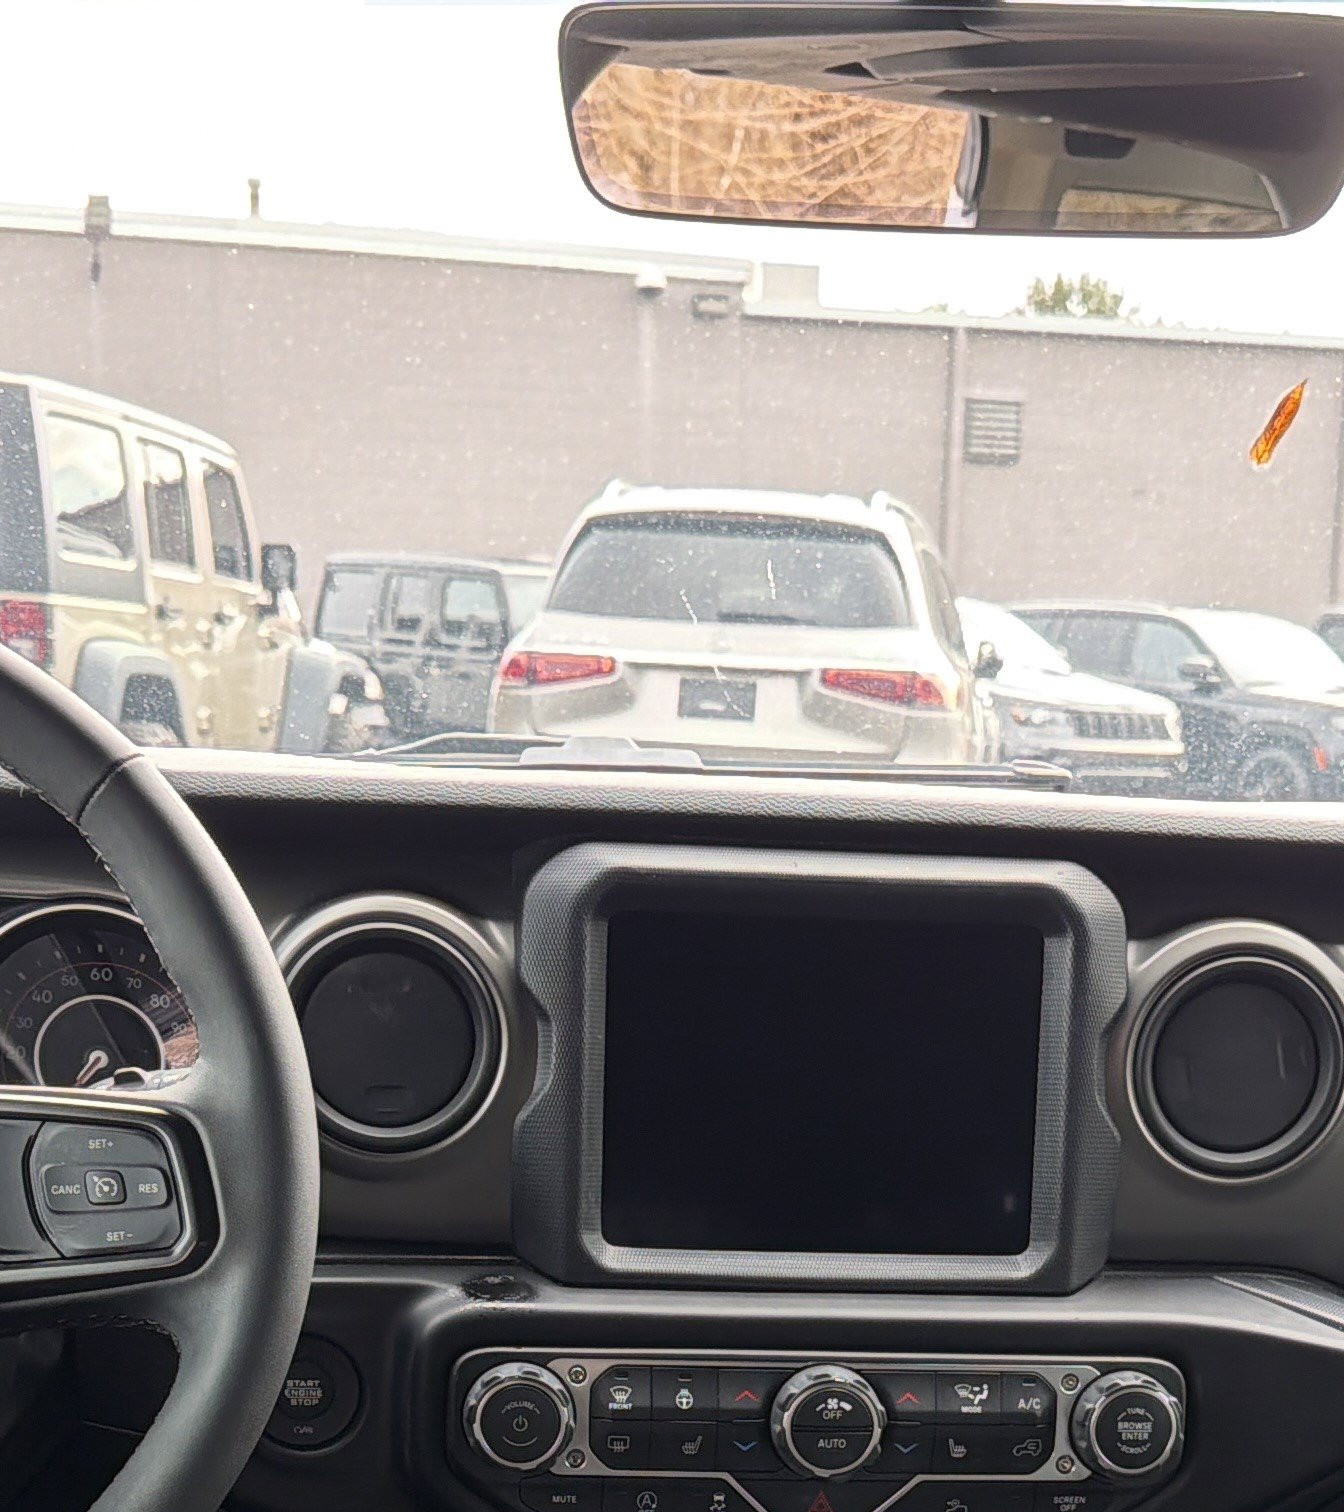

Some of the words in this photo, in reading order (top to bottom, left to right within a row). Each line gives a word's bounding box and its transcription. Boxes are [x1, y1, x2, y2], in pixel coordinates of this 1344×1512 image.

[89, 967, 113, 982] 60
[60, 975, 80, 987] 50
[126, 977, 143, 989] 70
[32, 989, 53, 1004] 40
[149, 994, 171, 1009] 80
[16, 1016, 34, 1029] 30
[51, 1184, 81, 1195] CANC
[138, 1183, 159, 1194] RES
[286, 1379, 321, 1387] START
[284, 1388, 323, 1398] ENGINE
[290, 1398, 320, 1406] STOP
[506, 1401, 536, 1411] VOLUME
[608, 1402, 633, 1411] FRONT
[1017, 1398, 1041, 1410] A/C
[960, 1405, 982, 1413] MODE
[822, 1410, 843, 1421] OFF
[1117, 1421, 1153, 1430] BROWSE
[1121, 1432, 1149, 1441] ENTER
[817, 1438, 847, 1449] AUTO
[552, 1495, 577, 1504] MUTE
[1053, 1496, 1087, 1504] SCREEN
[1059, 1504, 1077, 1512] OFF
